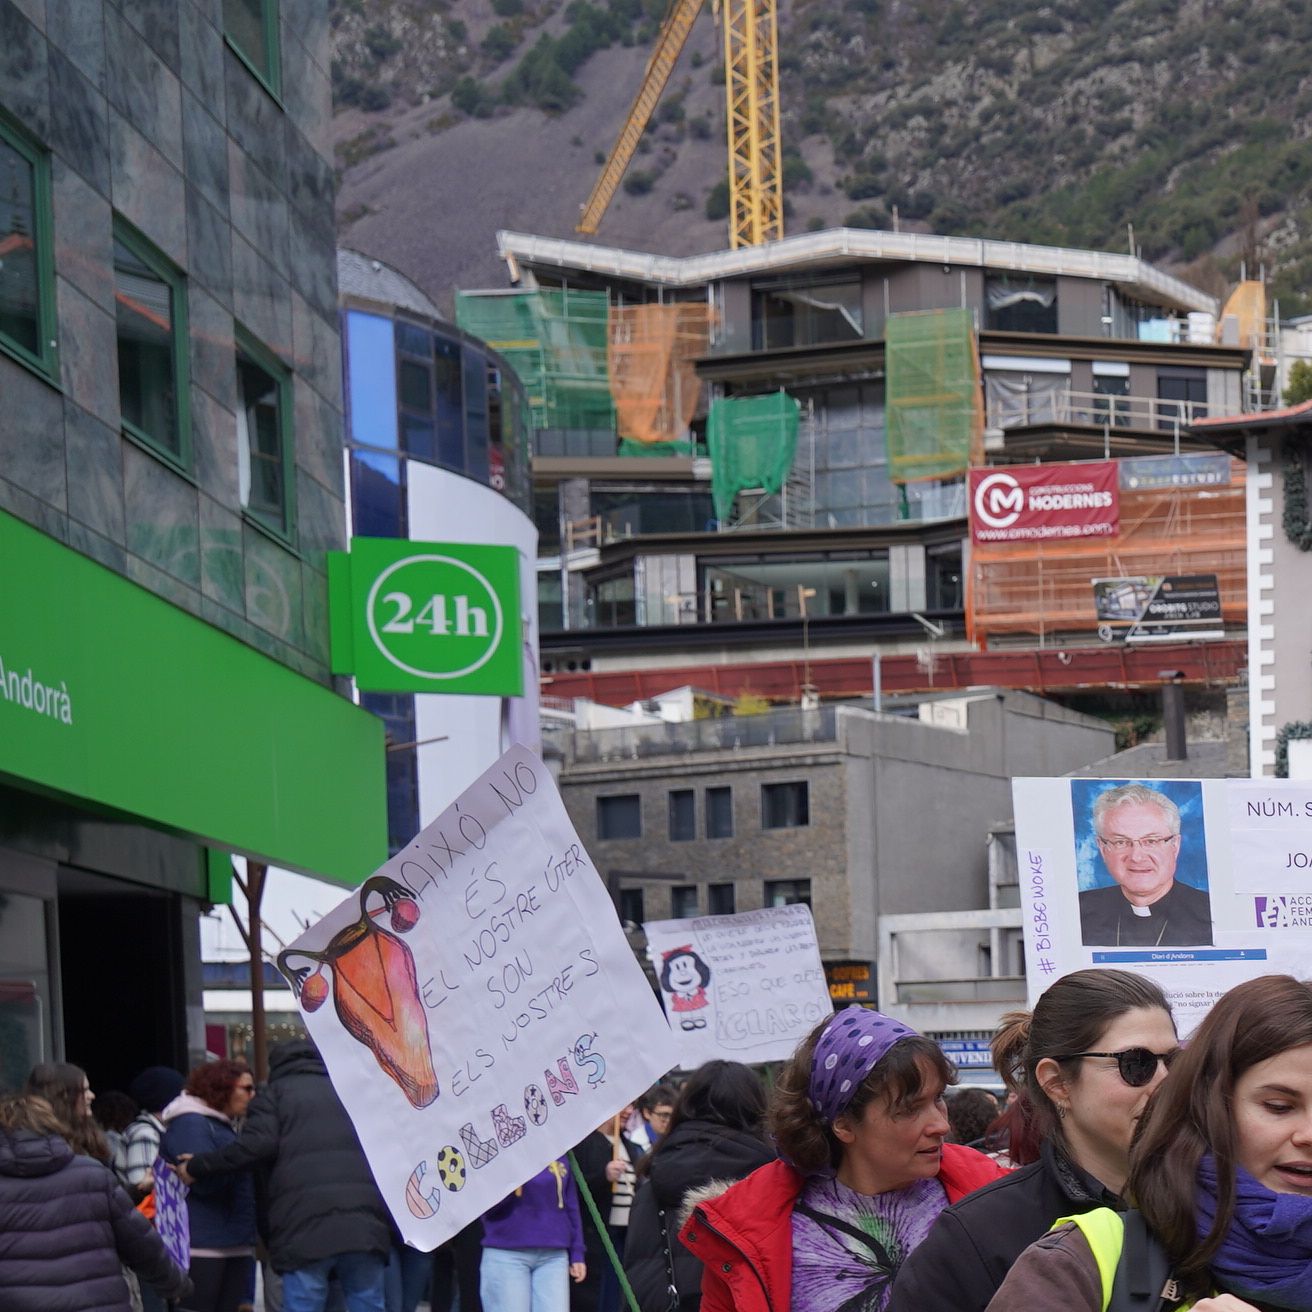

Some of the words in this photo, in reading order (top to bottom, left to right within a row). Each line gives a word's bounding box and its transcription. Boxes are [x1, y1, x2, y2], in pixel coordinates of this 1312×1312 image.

[1029, 491, 1113, 512] MODERNES
[381, 592, 490, 637] 24h
[489, 761, 537, 816] NO
[1246, 797, 1299, 818] NÚM.
[464, 861, 507, 920] ÉS
[421, 969, 459, 1009] EL
[463, 886, 542, 972] NOSTRE
[543, 843, 587, 893] ÚTER
[486, 948, 533, 1010] SON
[1163, 991, 1184, 999] lució
[1185, 990, 1206, 999] sobre
[1206, 990, 1213, 999] la
[1188, 1000, 1211, 1009] signar
[451, 1047, 496, 1097] ELS
[501, 949, 600, 1052] NOSTRES
[405, 1032, 606, 1220] COLLONS
